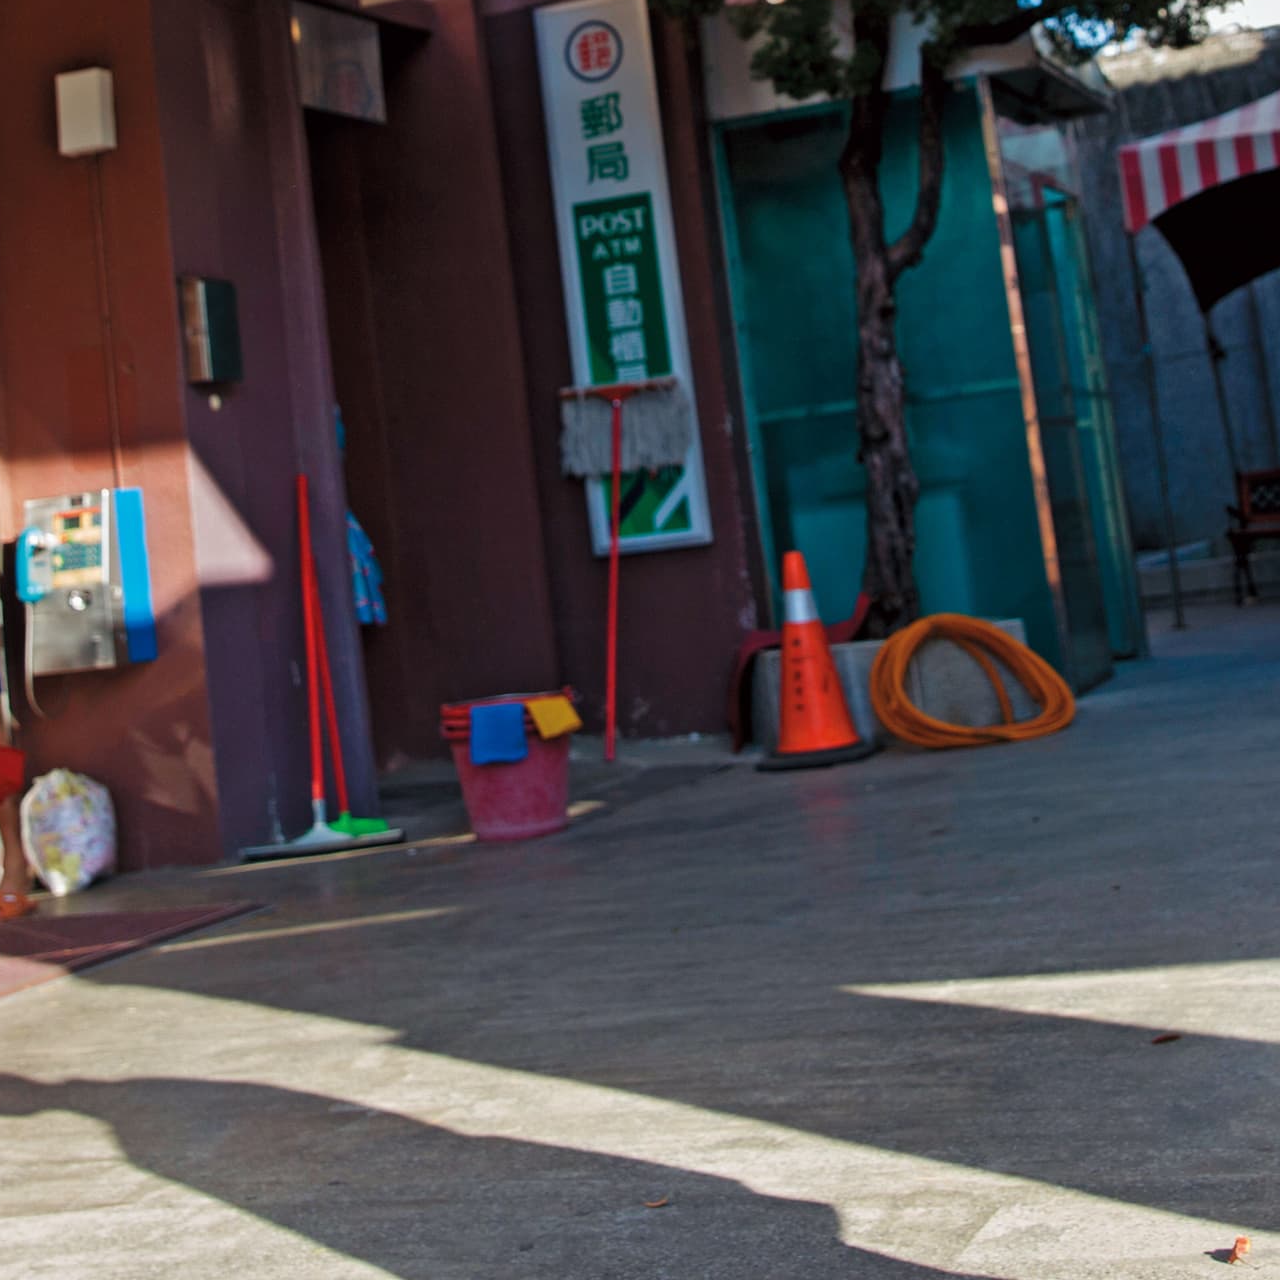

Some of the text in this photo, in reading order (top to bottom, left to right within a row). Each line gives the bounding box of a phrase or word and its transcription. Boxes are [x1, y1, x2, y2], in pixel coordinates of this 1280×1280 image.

[580, 91, 629, 184] 郵局
[579, 206, 646, 239] POST
[592, 237, 642, 260] ATM
